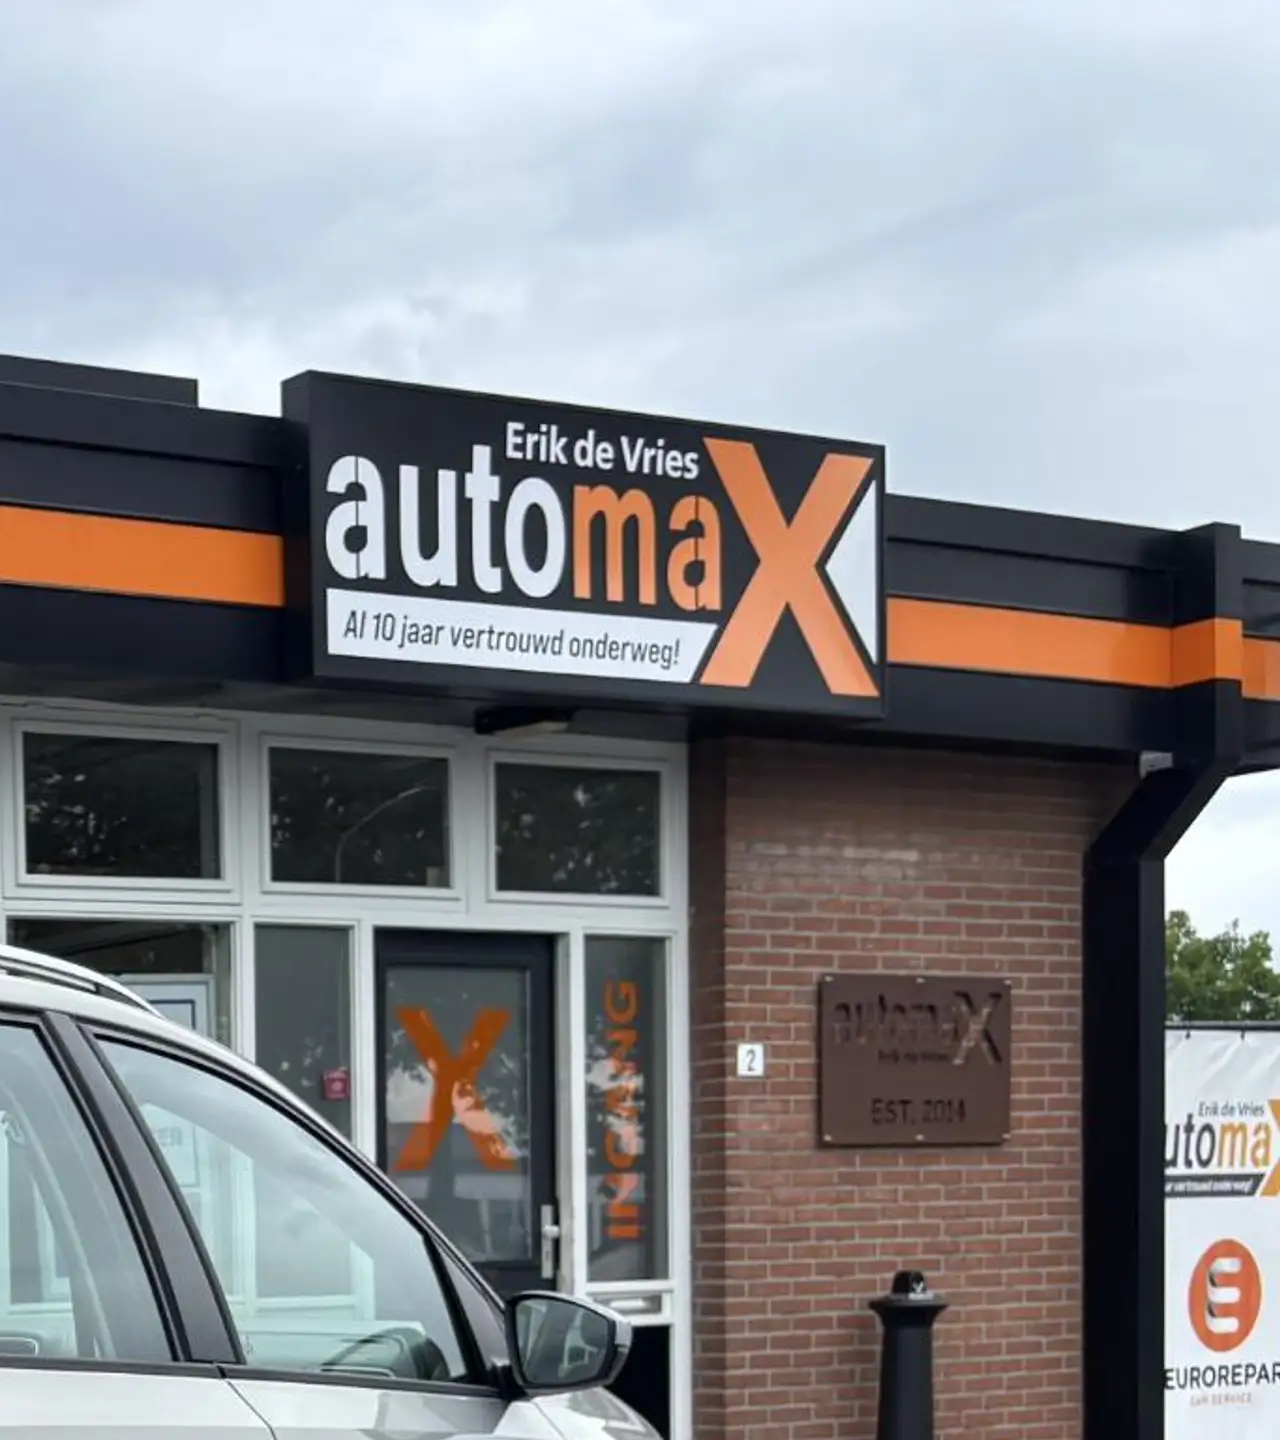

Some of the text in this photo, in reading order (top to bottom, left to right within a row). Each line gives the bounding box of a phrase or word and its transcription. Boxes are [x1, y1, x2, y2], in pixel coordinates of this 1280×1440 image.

[504, 421, 700, 480] Erik de Vries
[325, 436, 880, 698] automaX
[343, 610, 681, 672] Al 10 jaar vertrouwd onderweg!
[746, 1048, 757, 1072] 2
[1220, 1101, 1236, 1117] de
